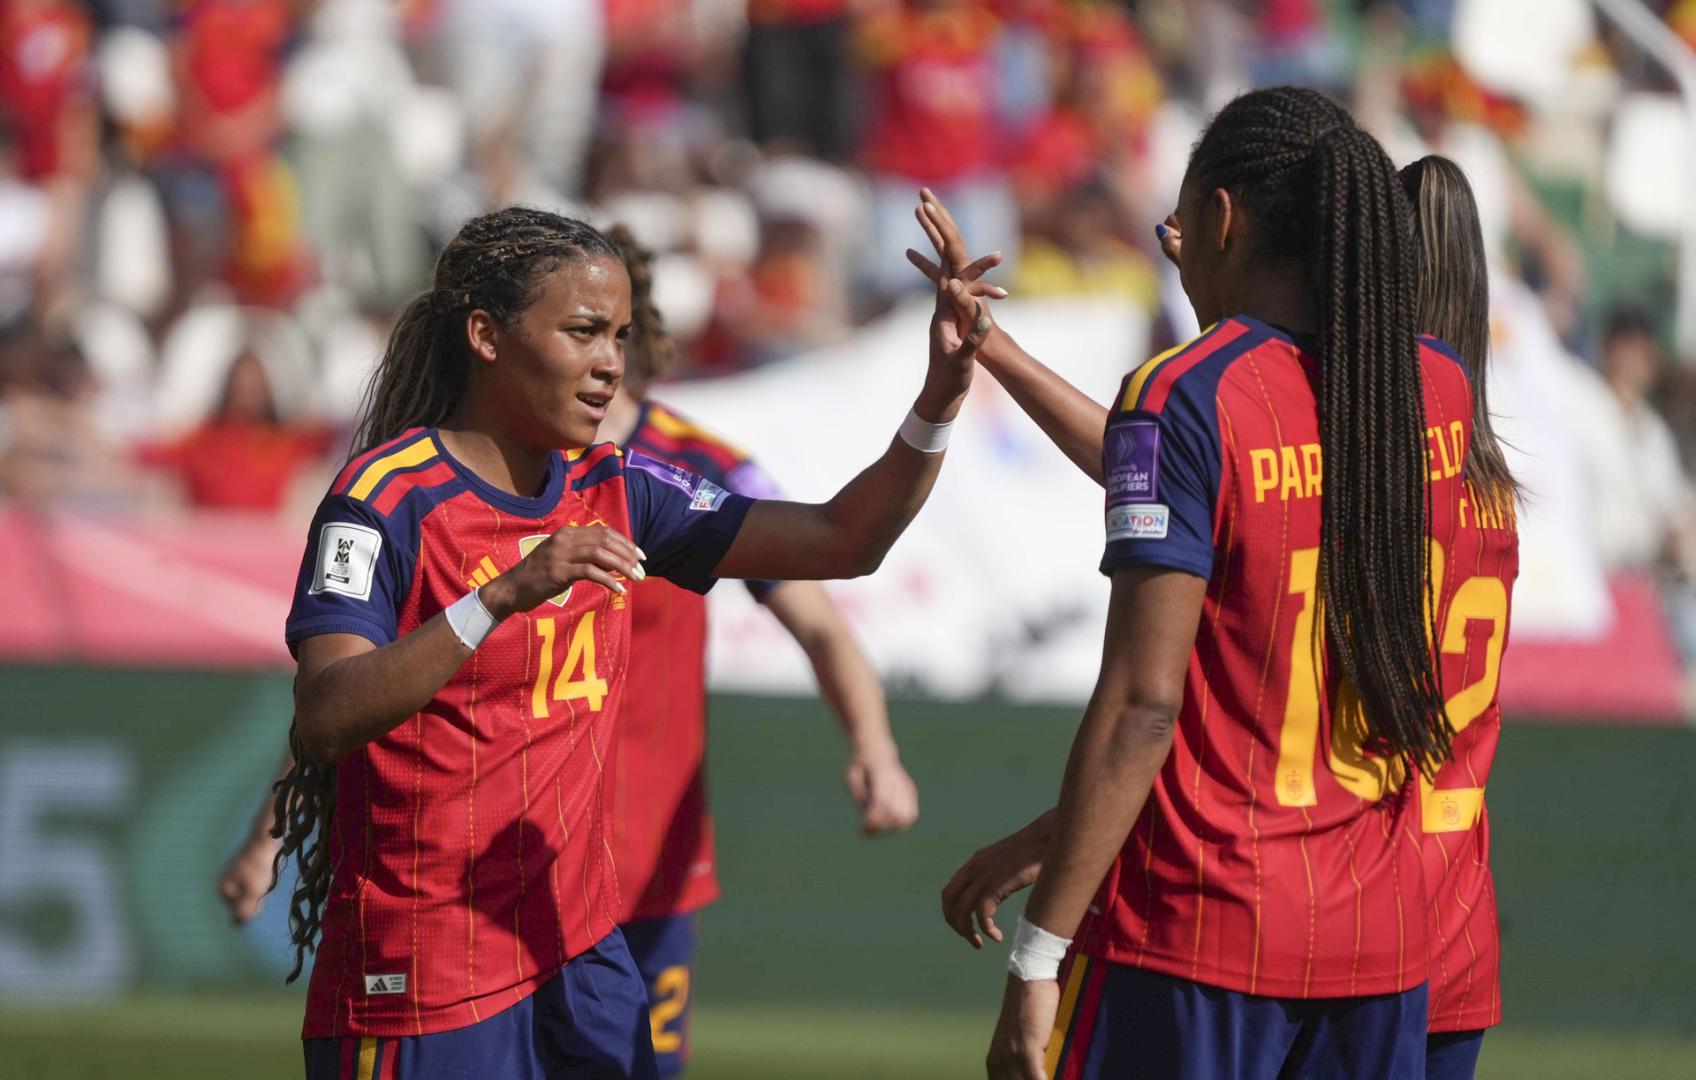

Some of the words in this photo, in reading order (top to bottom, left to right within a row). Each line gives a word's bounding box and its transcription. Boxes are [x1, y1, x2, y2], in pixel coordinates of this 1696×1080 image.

[1249, 420, 1465, 503] PARELO
[531, 611, 608, 718] 14
[0, 739, 131, 1002] 5
[648, 965, 689, 1053] 2
